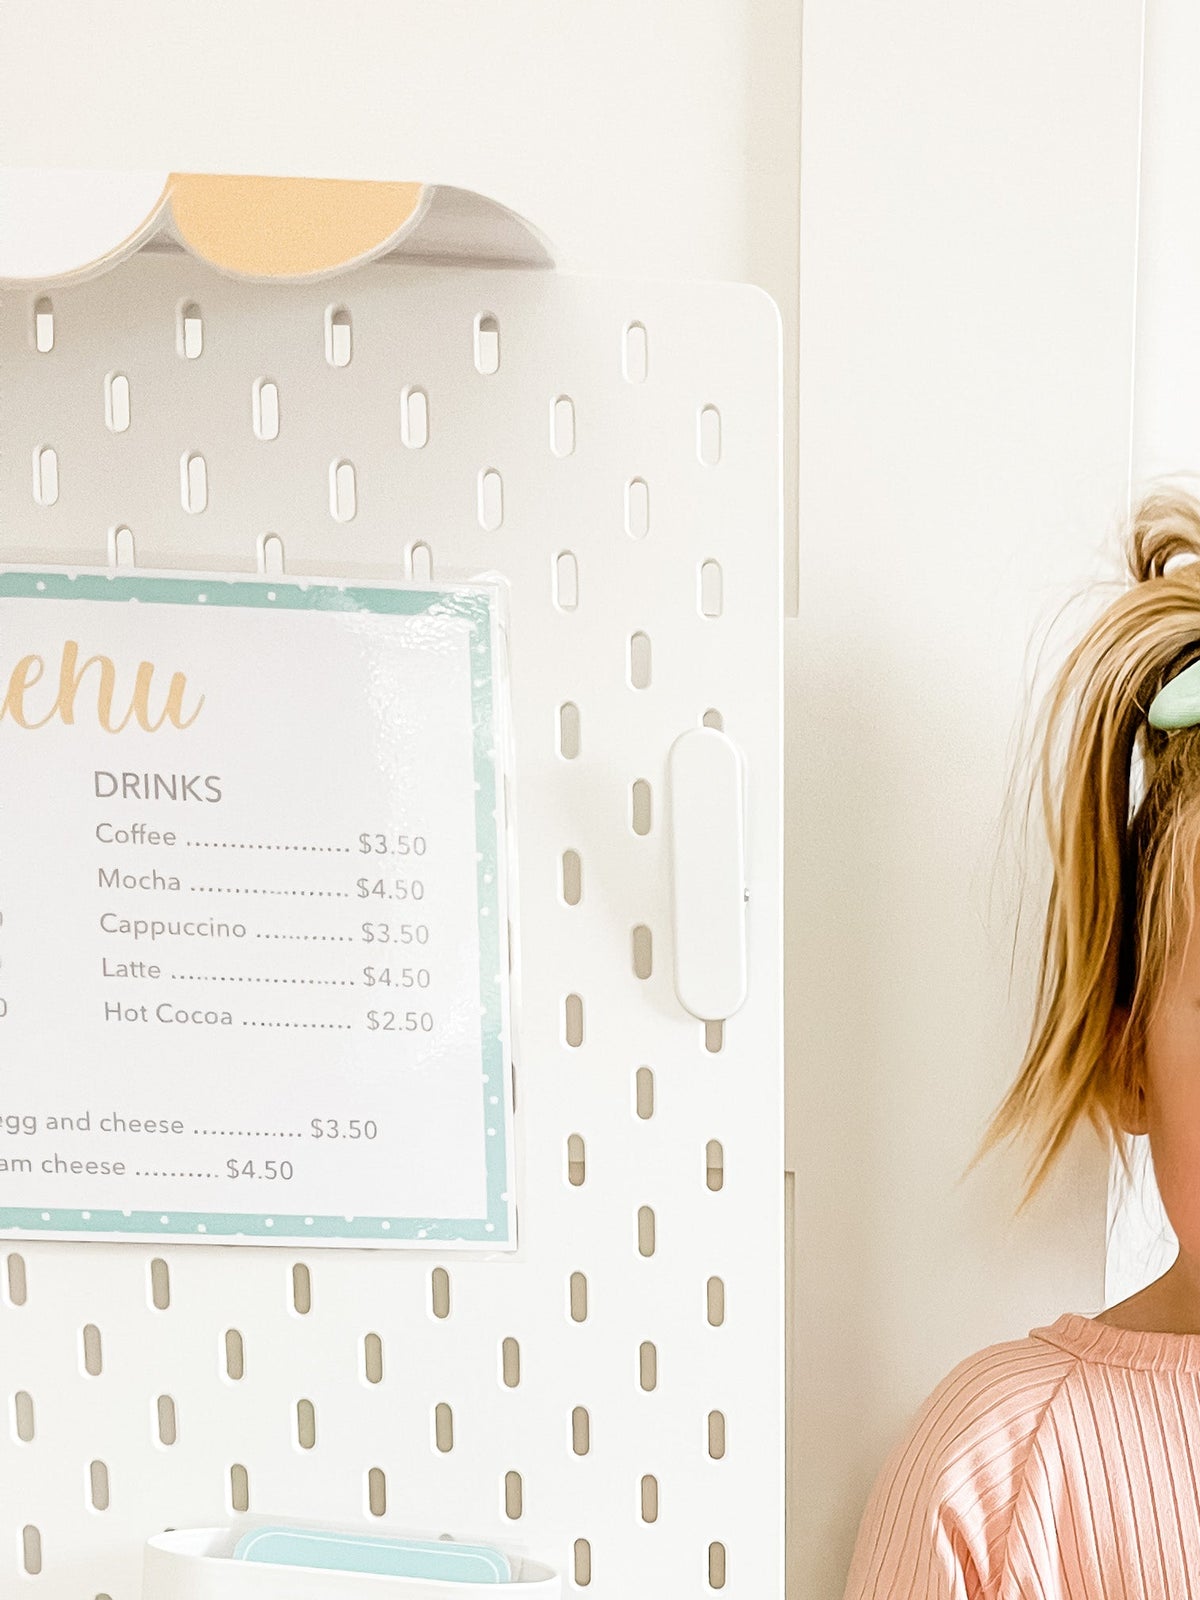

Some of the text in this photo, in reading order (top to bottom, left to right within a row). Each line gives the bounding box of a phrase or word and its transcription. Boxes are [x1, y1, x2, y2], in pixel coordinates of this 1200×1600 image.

[0, 640, 205, 734] enu
[95, 771, 222, 803] DRINKS
[96, 822, 427, 856] Coffee $3.50
[98, 867, 425, 901] Mocha $4.50
[100, 912, 430, 946] Cappuccino $3.50
[102, 957, 431, 990] Latte $4.50
[104, 1001, 434, 1034] Hot Cocoa $2.50
[46, 1110, 91, 1132] and
[100, 1111, 184, 1134] cheese
[310, 1118, 378, 1142] $3.50
[41, 1152, 126, 1176] cheese
[226, 1158, 294, 1183] $4.50
